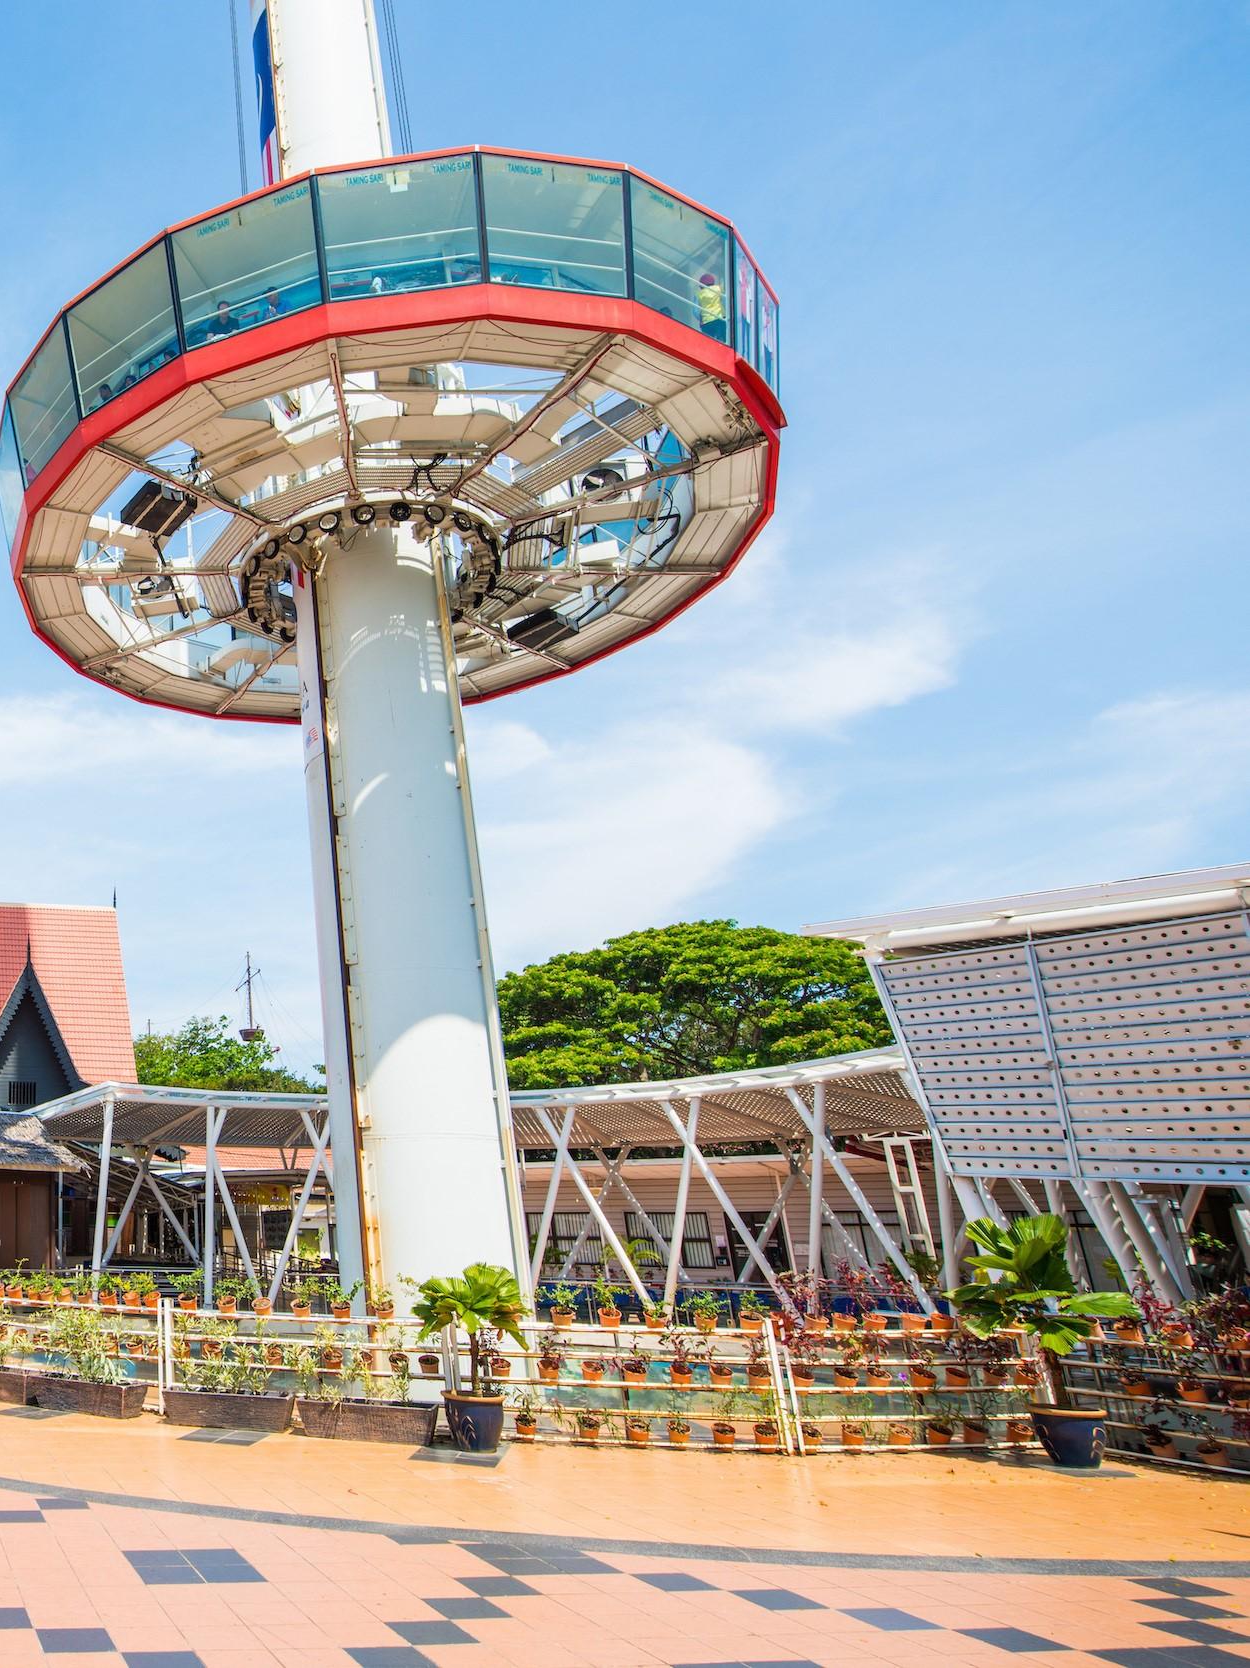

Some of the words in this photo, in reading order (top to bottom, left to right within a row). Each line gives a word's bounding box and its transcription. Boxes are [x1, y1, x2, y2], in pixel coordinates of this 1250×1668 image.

[432, 162, 456, 174] TAMING
[457, 160, 471, 171] SARI
[507, 163, 529, 174] TAMING
[345, 174, 369, 186] TAMING
[370, 173, 383, 184] SARI
[273, 191, 295, 207] TAMING
